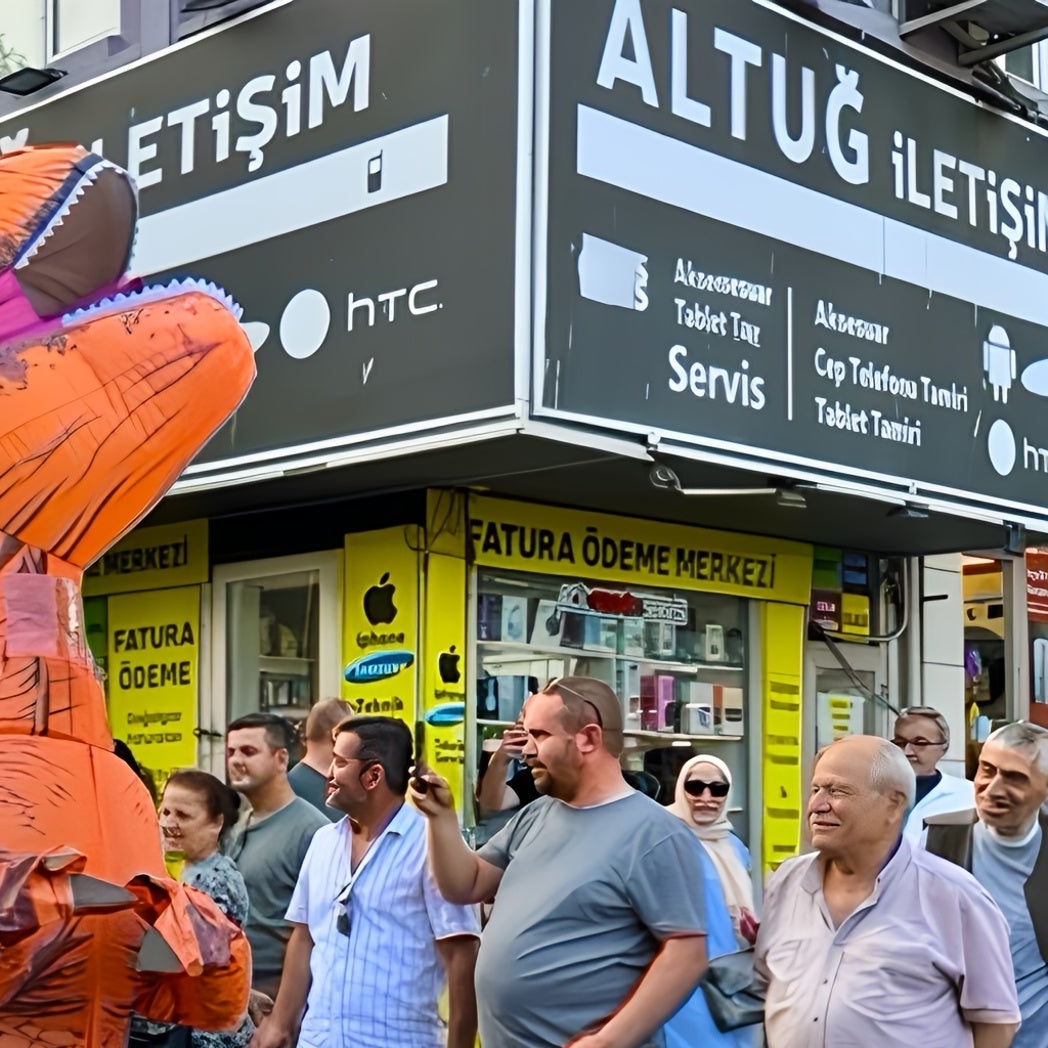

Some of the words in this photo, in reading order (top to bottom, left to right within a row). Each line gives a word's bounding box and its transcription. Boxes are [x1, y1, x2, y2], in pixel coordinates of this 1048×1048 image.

[596, 0, 869, 185] ALTUĞ
[668, 344, 766, 410] Servis
[469, 518, 576, 564] FATURA
[582, 526, 671, 576] ÖDEME
[675, 547, 777, 589] MERKEZİ
[114, 621, 195, 653] FATURA
[119, 660, 191, 690] ÖDEME
